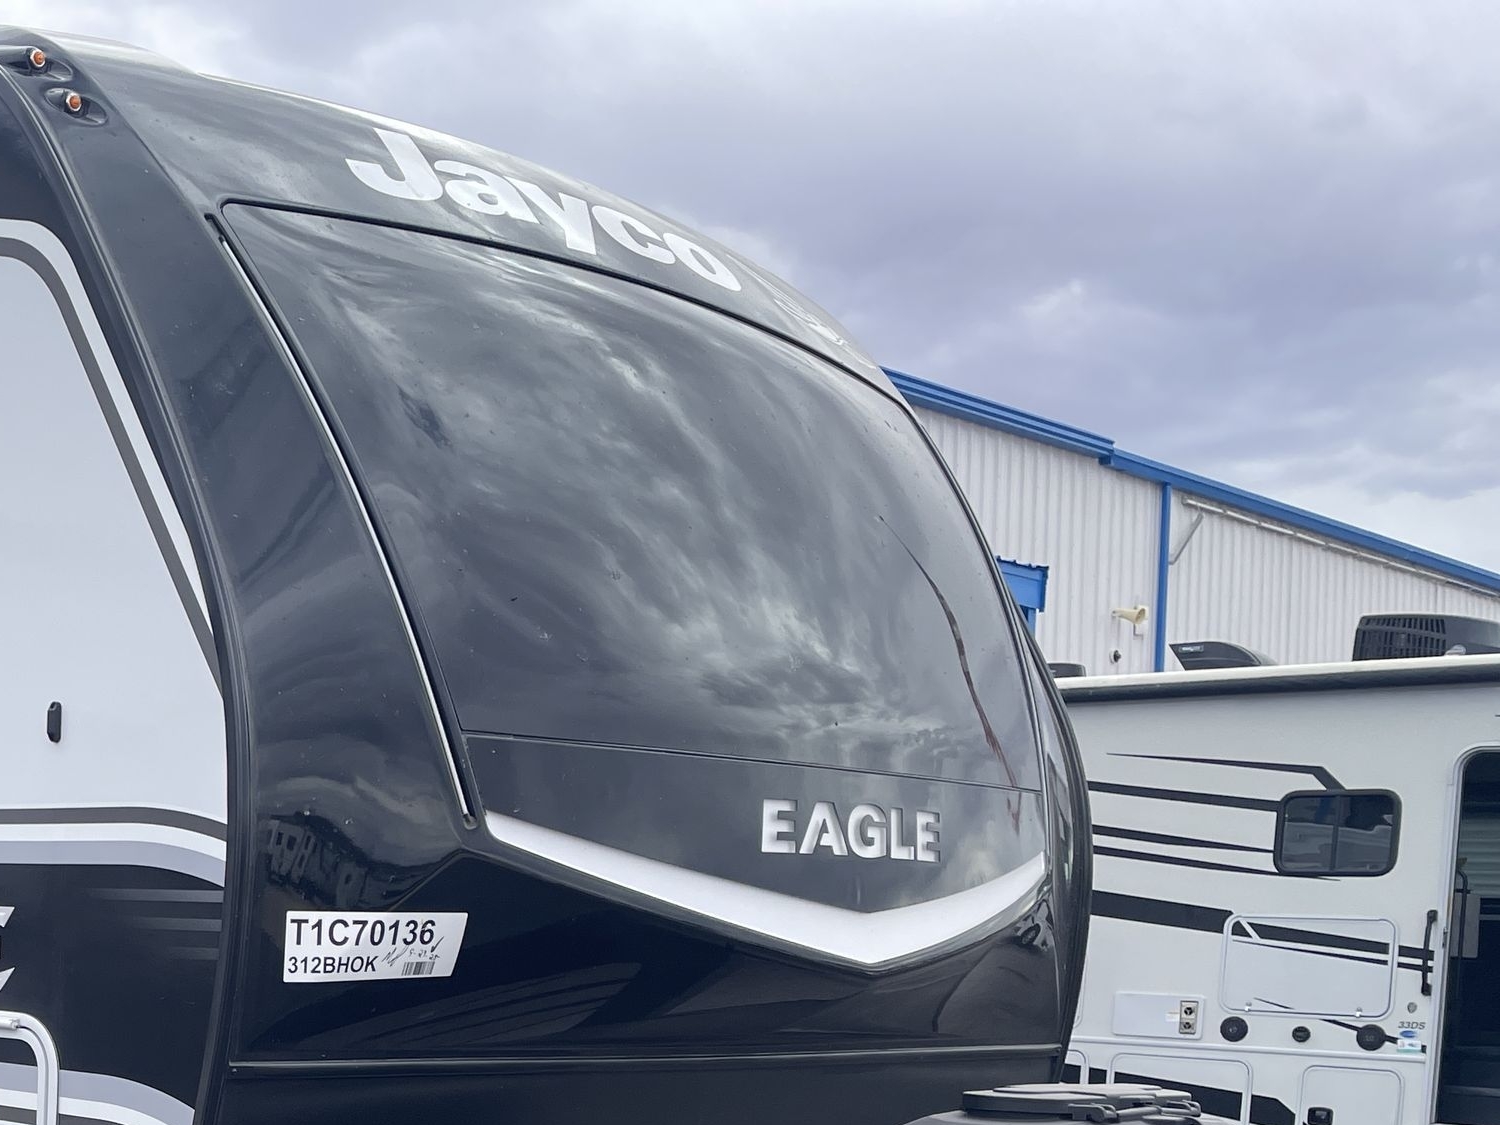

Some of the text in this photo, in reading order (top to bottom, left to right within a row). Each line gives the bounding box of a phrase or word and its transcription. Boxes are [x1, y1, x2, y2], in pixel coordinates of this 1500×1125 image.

[345, 127, 741, 291] Jayco
[761, 799, 941, 863] EAGLE
[290, 918, 436, 947] T1C70136
[287, 955, 379, 974] 312BHOK
